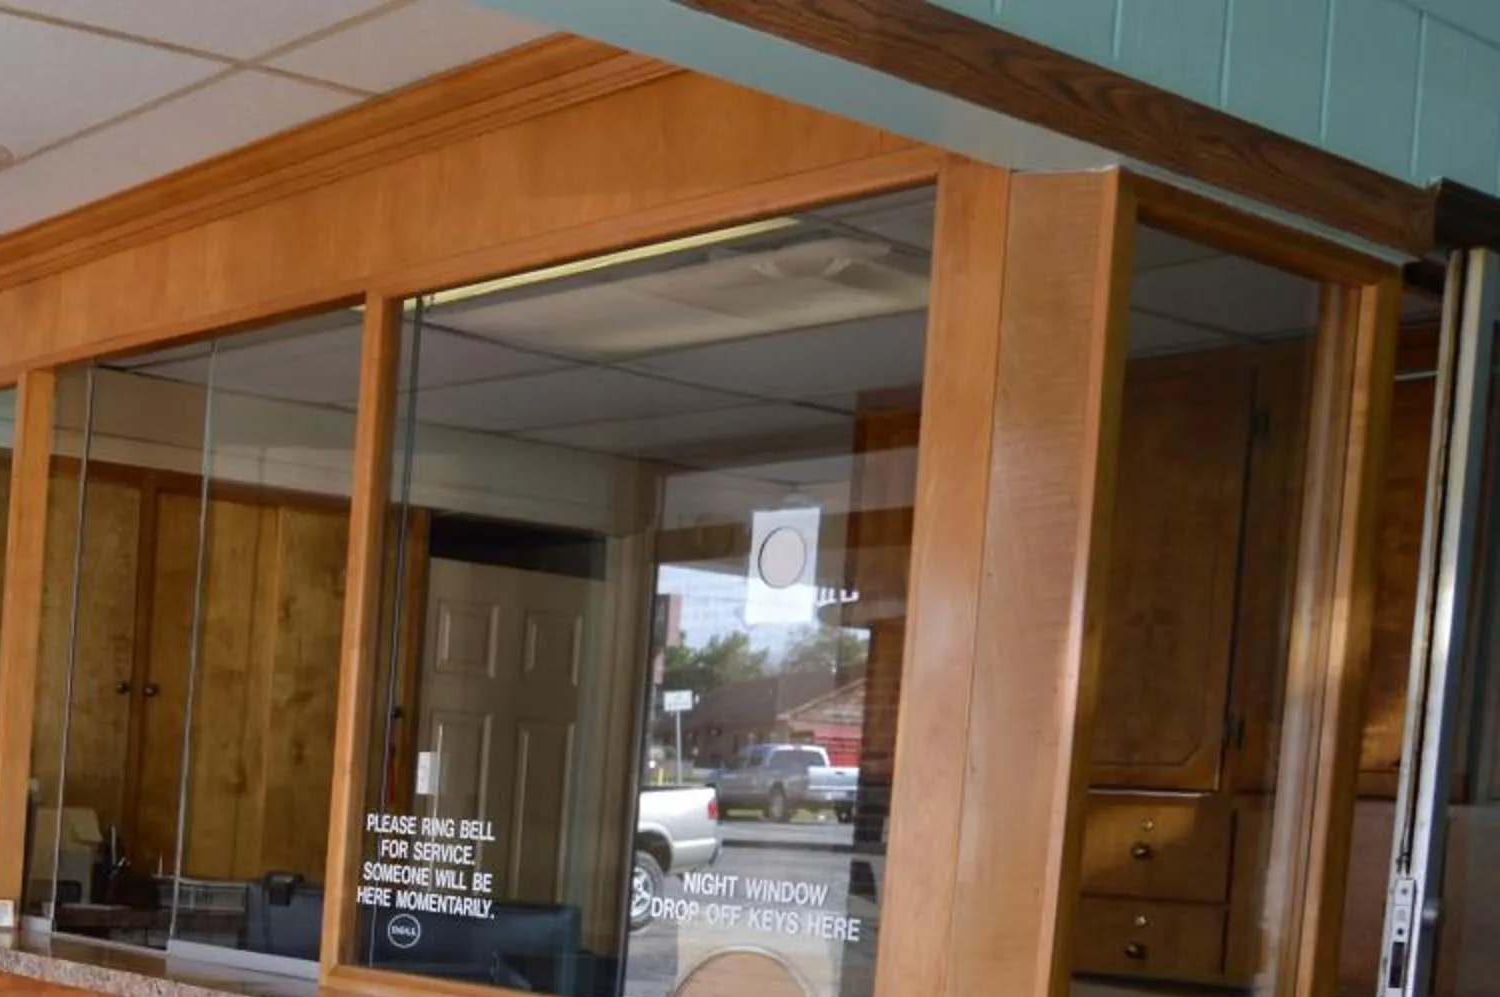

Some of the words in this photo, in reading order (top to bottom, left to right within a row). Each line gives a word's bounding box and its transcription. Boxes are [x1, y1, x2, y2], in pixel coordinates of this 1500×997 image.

[366, 813, 417, 835] PLEASE
[421, 817, 455, 838] RING
[459, 819, 496, 841] BELL
[381, 839, 408, 859] FOR
[413, 841, 475, 865] SERVICE.
[363, 861, 429, 886] SOMEONE
[435, 868, 467, 890] WILL
[472, 872, 492, 893] BE
[683, 872, 739, 897] NIGHT
[745, 877, 829, 907] WINDOW
[356, 886, 392, 907] HERE
[395, 889, 495, 919] MOMENTARILY.
[650, 897, 700, 921] DROP
[706, 903, 742, 927] OFF
[748, 905, 799, 935] KEYS
[807, 914, 862, 943] HERE
